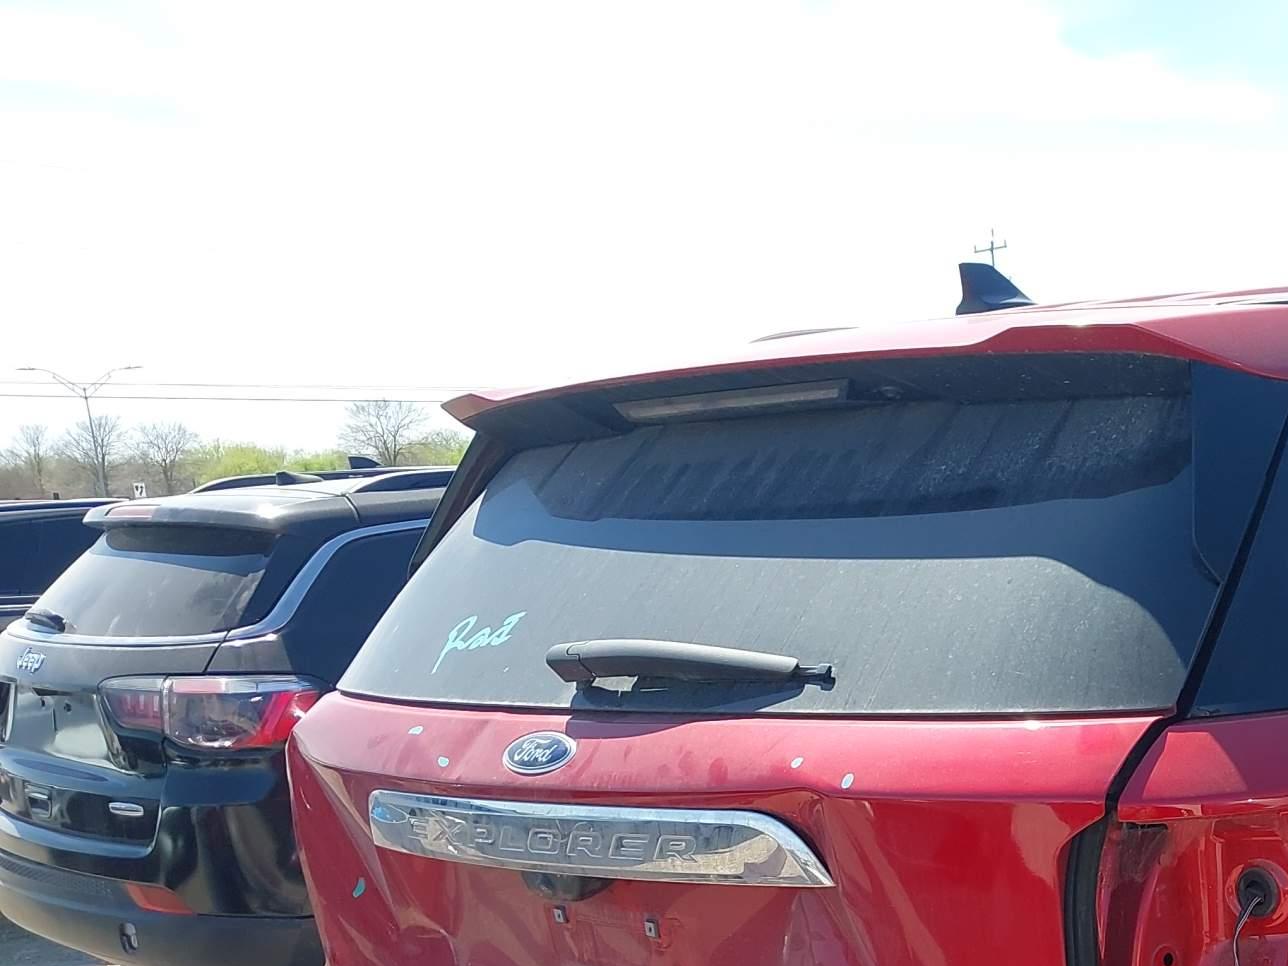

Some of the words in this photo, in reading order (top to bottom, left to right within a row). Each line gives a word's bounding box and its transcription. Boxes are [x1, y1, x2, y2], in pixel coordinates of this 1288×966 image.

[17, 648, 46, 673] Jeep
[513, 738, 558, 763] Ford
[408, 811, 698, 862] EXPLORER
